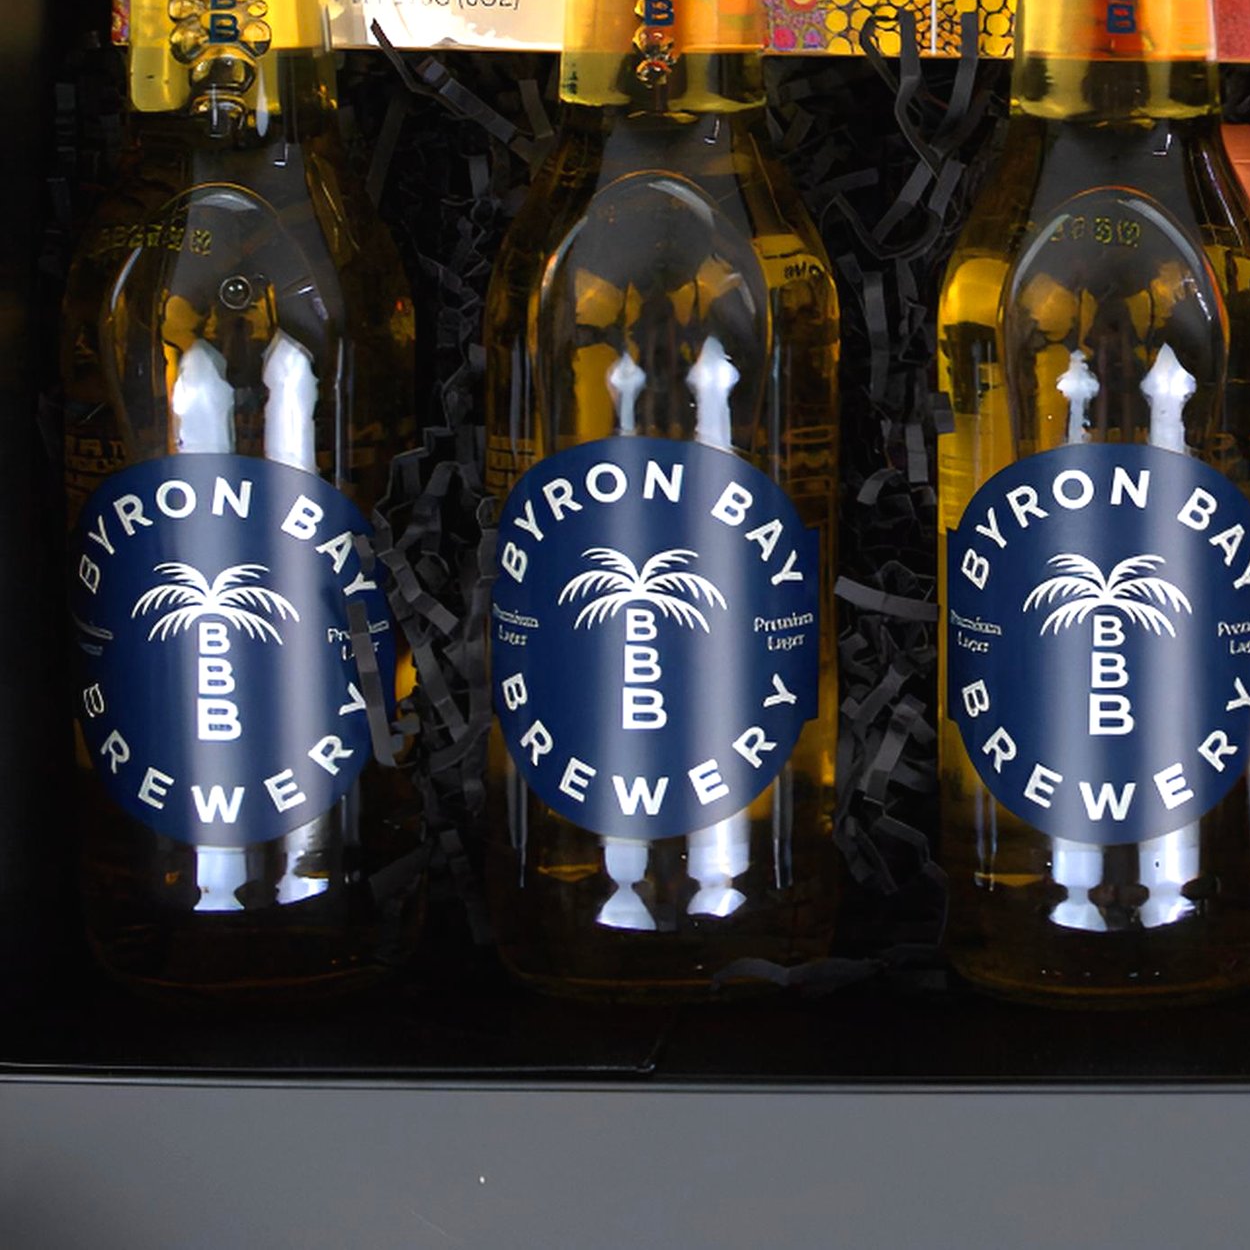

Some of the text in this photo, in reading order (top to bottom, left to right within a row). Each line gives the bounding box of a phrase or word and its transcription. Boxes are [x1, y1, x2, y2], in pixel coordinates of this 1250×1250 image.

[78, 476, 378, 598] BYRON BAY
[501, 460, 804, 587] BYRON BAY
[961, 466, 1150, 591] BYRON
[198, 622, 241, 740] BBB
[622, 608, 667, 730] BBB
[1089, 614, 1134, 735] BBB
[83, 682, 366, 824] BREWERY
[502, 673, 797, 816] BREWERY
